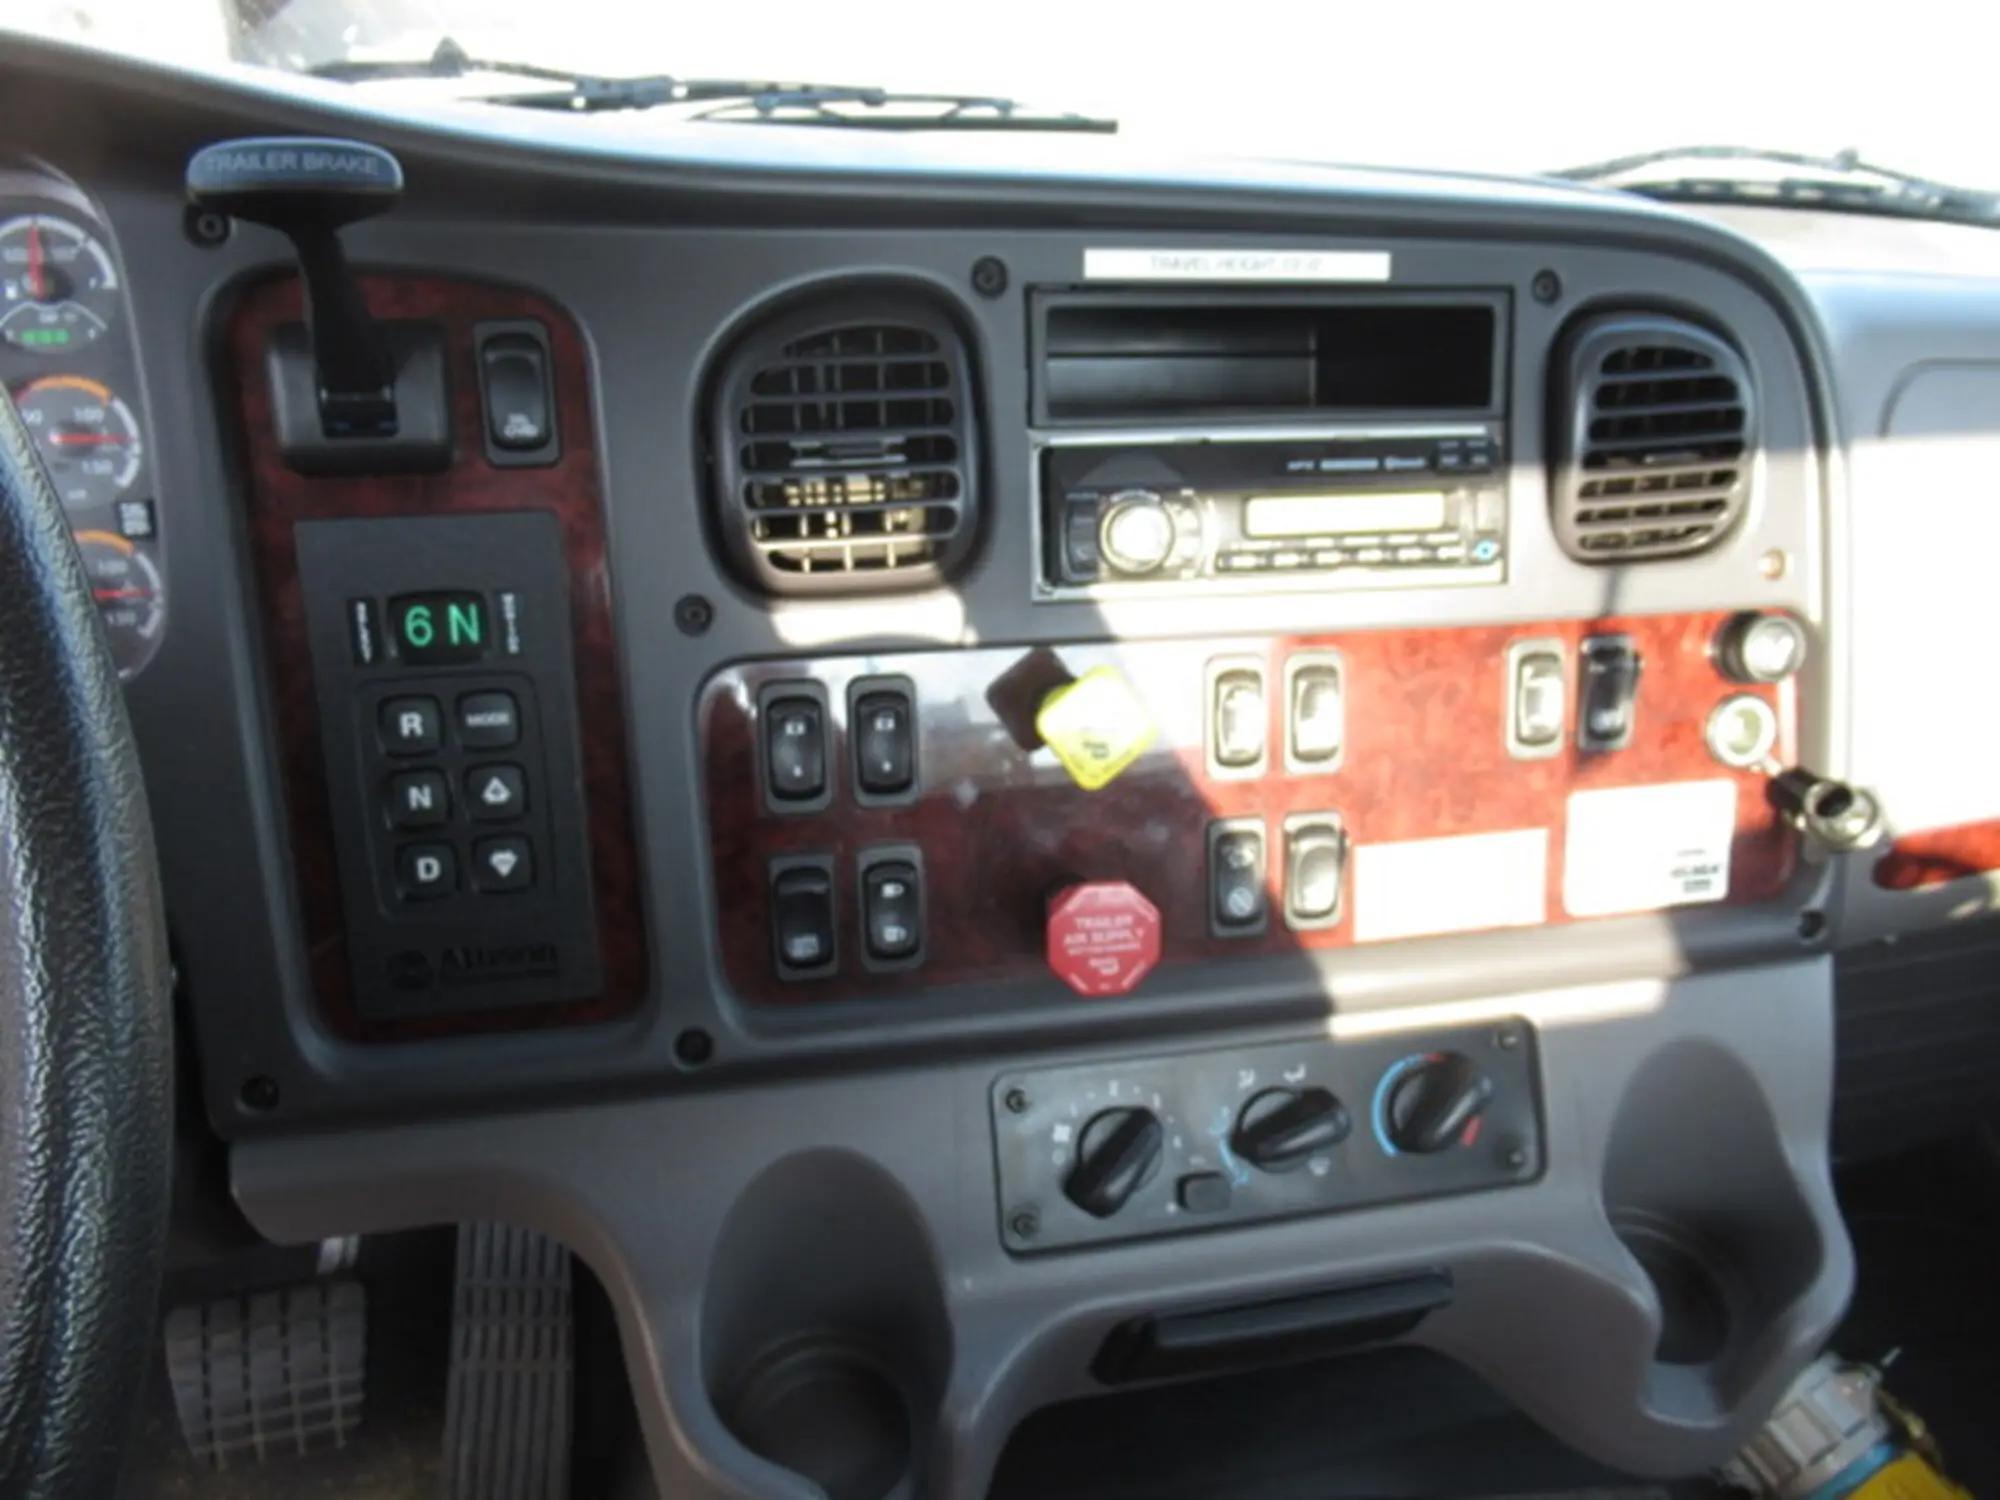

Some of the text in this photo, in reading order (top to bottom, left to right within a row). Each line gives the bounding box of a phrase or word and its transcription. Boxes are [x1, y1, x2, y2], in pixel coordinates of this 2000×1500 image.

[206, 152, 379, 175] TRAILER BRAKE
[404, 605, 433, 646] 6
[448, 602, 481, 645] N
[399, 711, 424, 737] R
[408, 784, 433, 810] N
[416, 857, 442, 881] D
